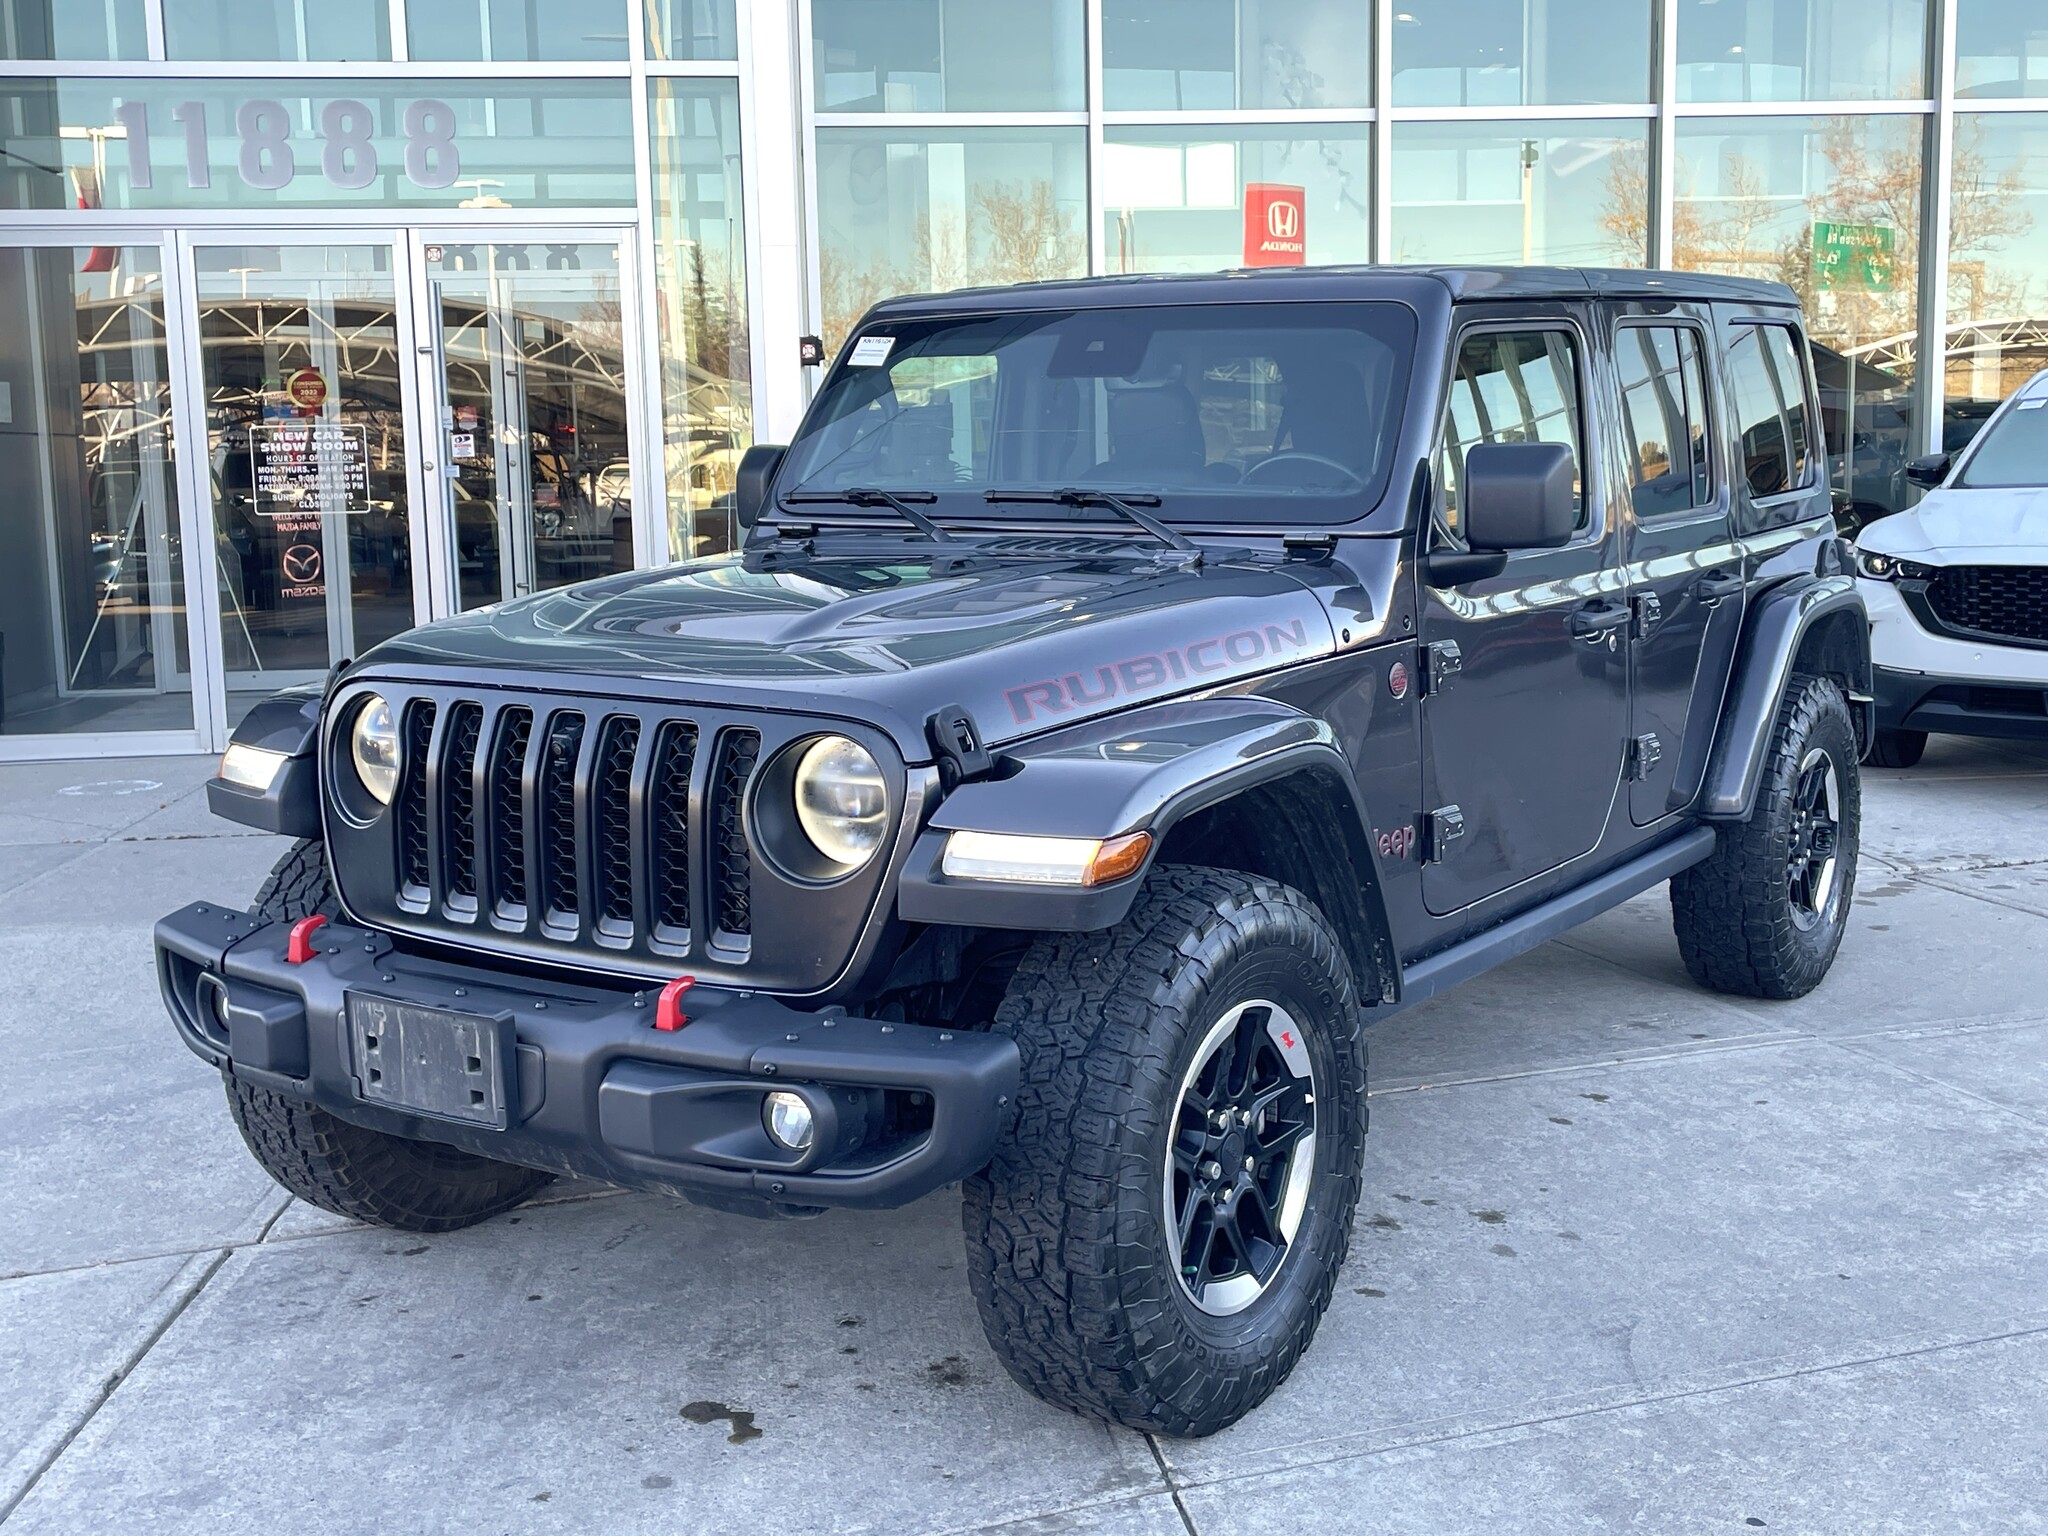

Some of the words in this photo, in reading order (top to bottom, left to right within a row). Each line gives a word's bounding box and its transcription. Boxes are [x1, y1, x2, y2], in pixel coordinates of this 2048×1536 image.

[115, 99, 460, 190] 11888
[273, 432, 308, 441] NEW
[313, 431, 345, 440] CAR
[260, 442, 307, 452] SHOW
[311, 441, 359, 451] ROOM
[266, 454, 294, 462] HOURS
[258, 475, 288, 483] FRIDAY
[276, 523, 300, 532] MAZDA
[300, 522, 322, 531] FAMILY
[1003, 617, 1309, 725] RUBICON
